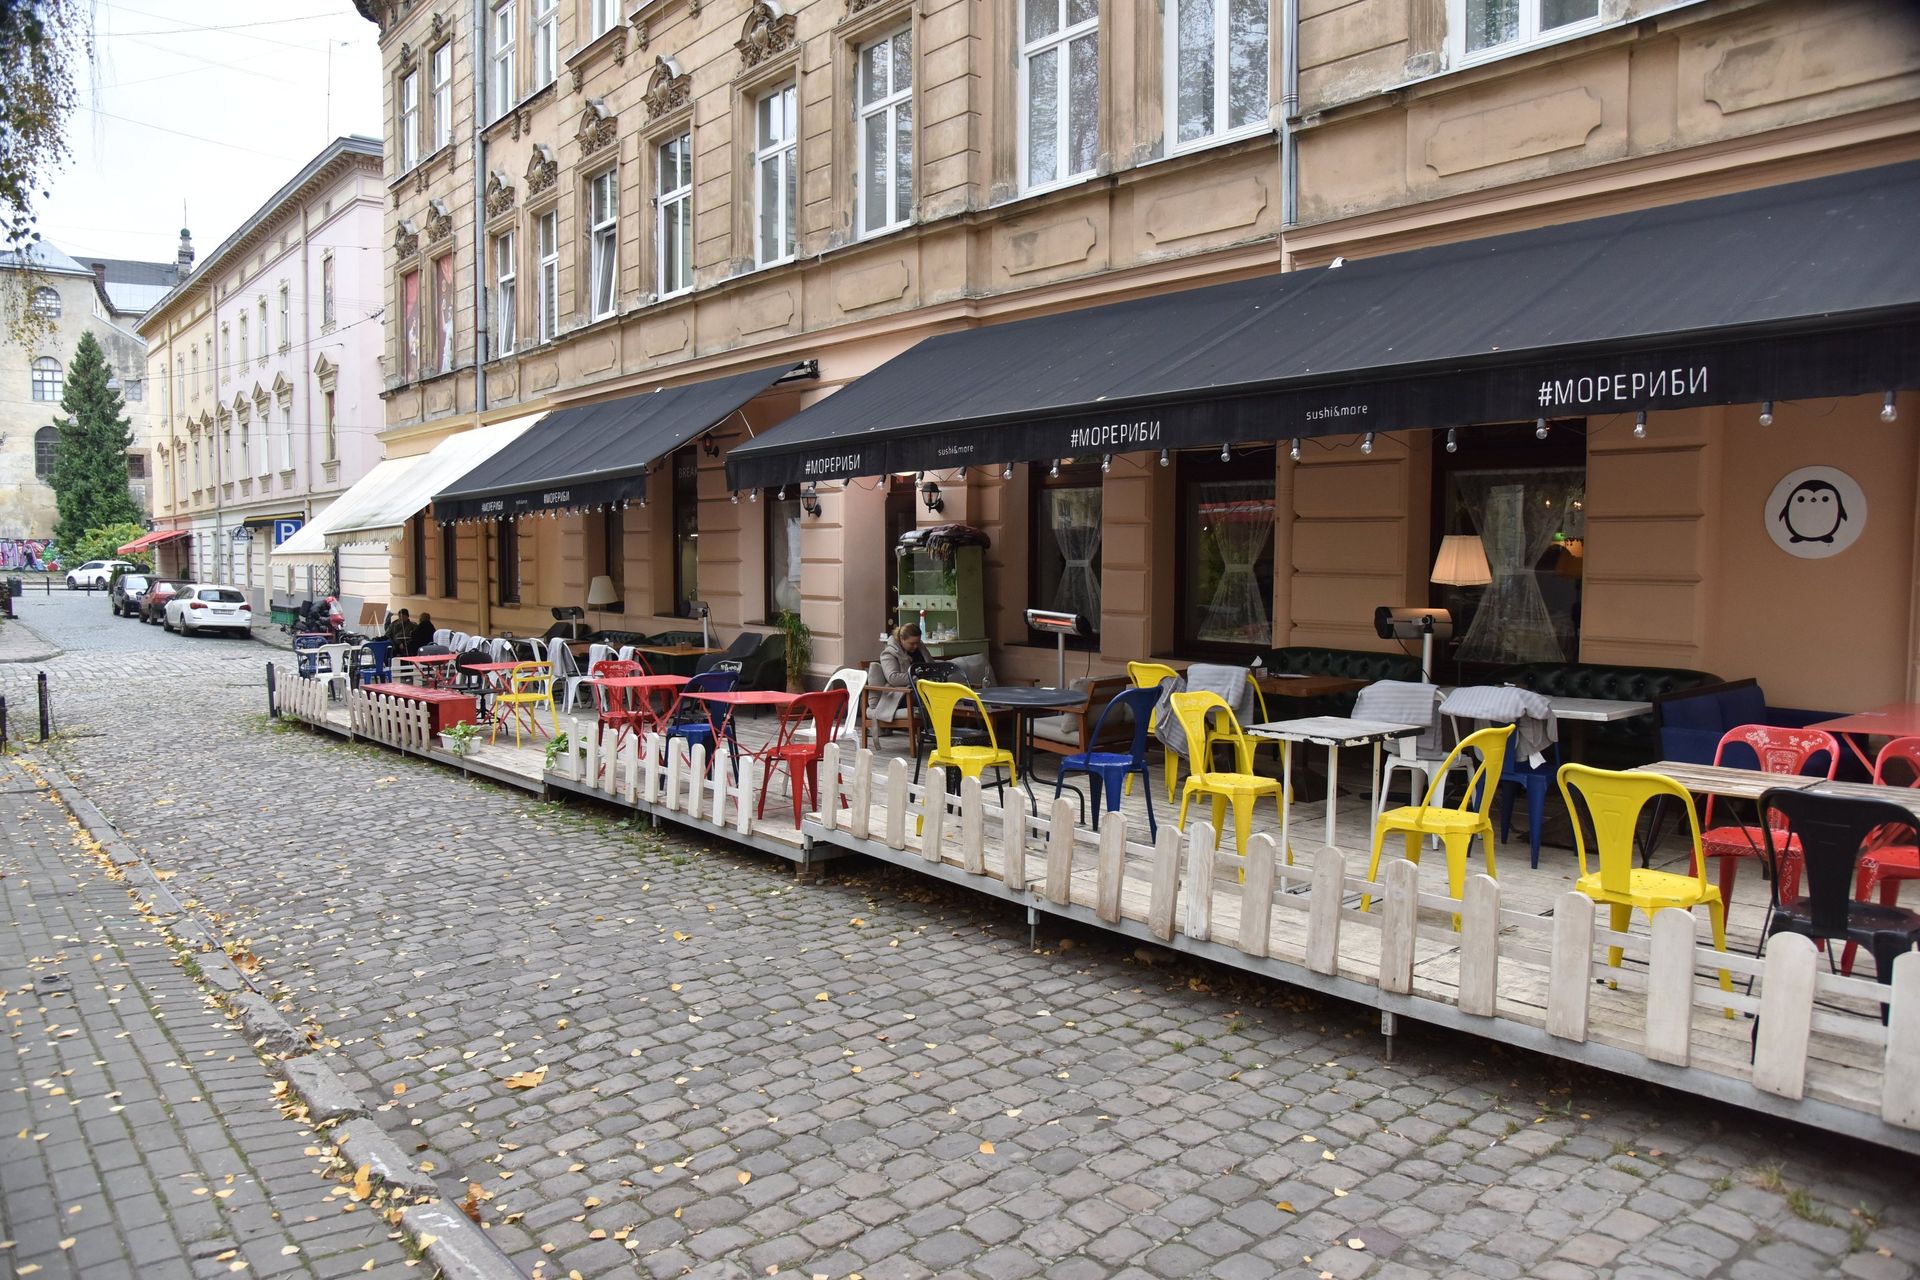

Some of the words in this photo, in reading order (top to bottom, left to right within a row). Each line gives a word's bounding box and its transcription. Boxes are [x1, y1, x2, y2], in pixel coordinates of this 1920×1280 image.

[1538, 366, 1708, 407] #МОРЕРИБИ
[1306, 403, 1369, 421] sushi&more
[1070, 420, 1161, 448] #МОРЕРИБИ
[937, 444, 975, 456] sushi&more
[805, 453, 861, 475] #МОРЕРИБИ
[280, 523, 296, 543] P
